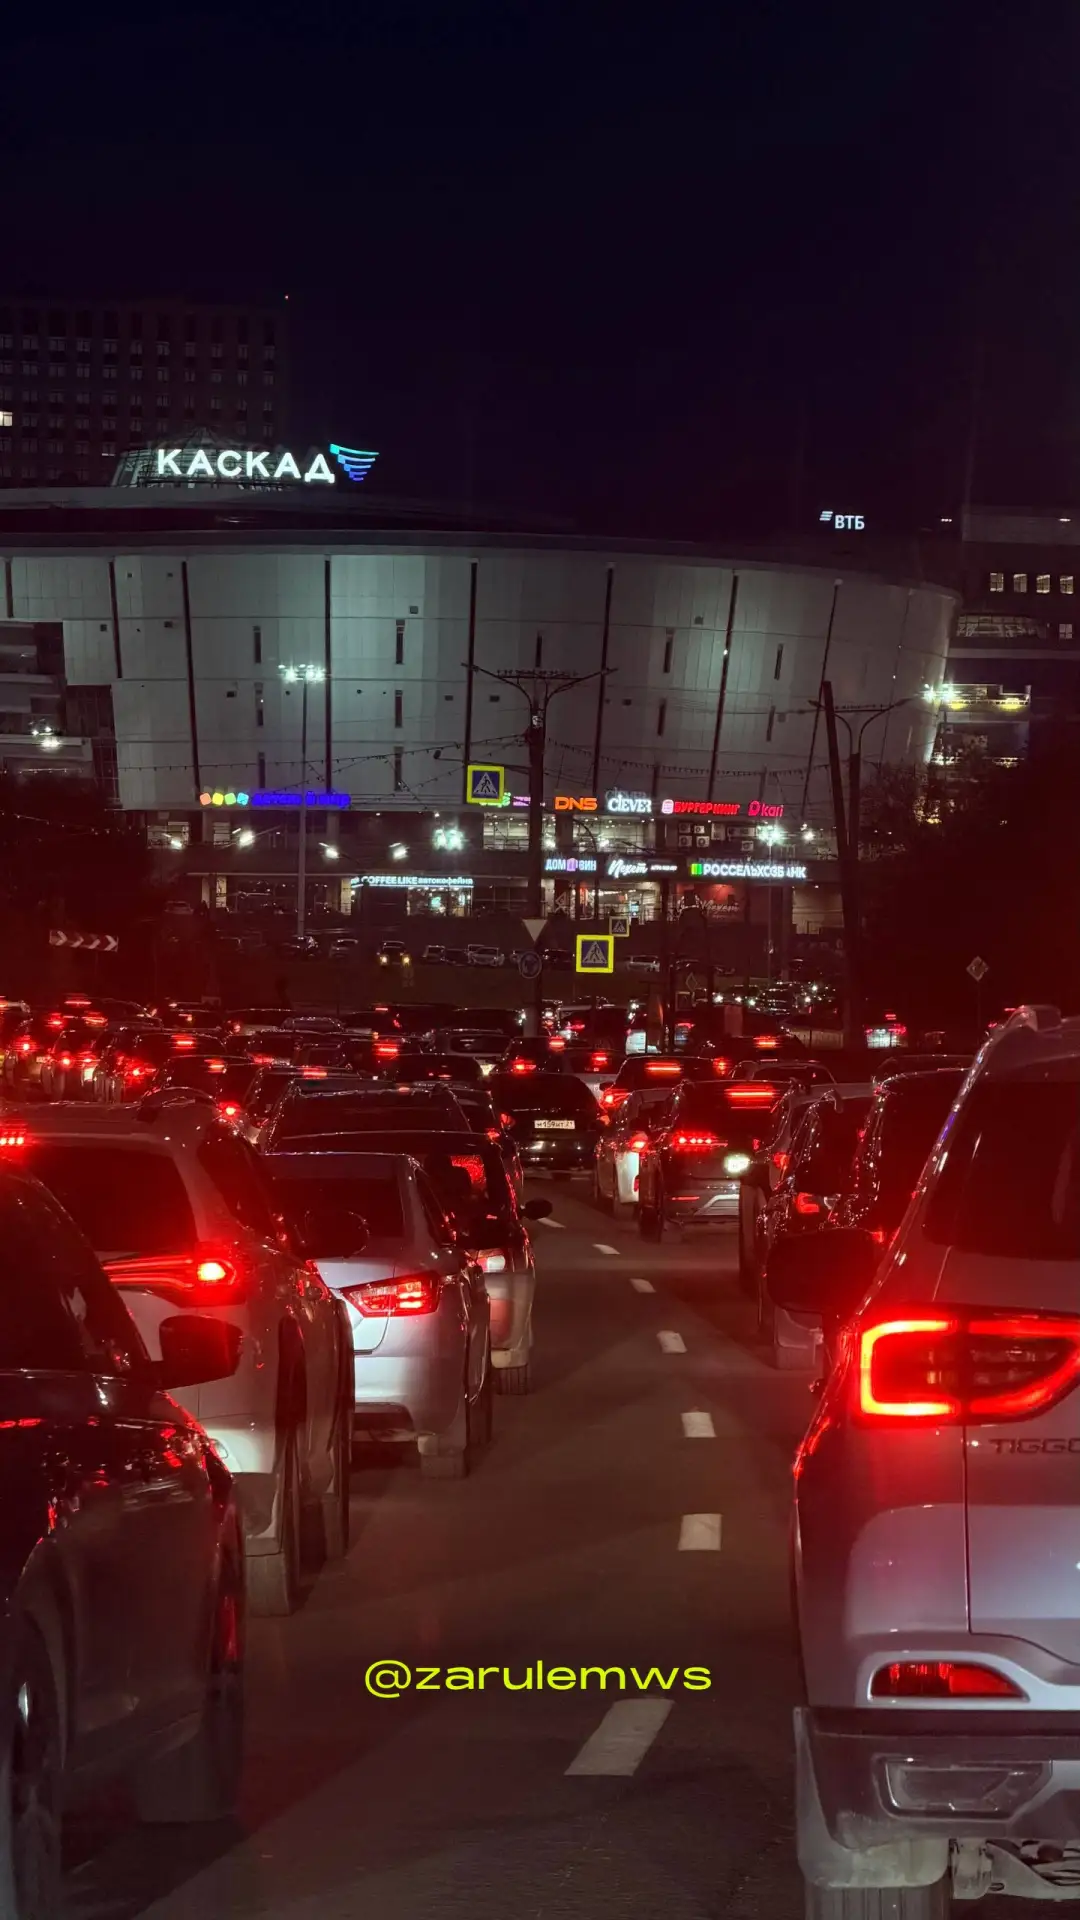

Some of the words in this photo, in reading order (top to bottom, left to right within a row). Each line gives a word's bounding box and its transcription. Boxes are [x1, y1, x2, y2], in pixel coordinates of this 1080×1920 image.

[157, 448, 336, 484] КАСКАД
[834, 514, 865, 530] ВТБ
[554, 796, 598, 811] DNS
[761, 803, 784, 818] kari
[545, 859, 566, 871] ДОМ
[398, 876, 418, 885] LIKE
